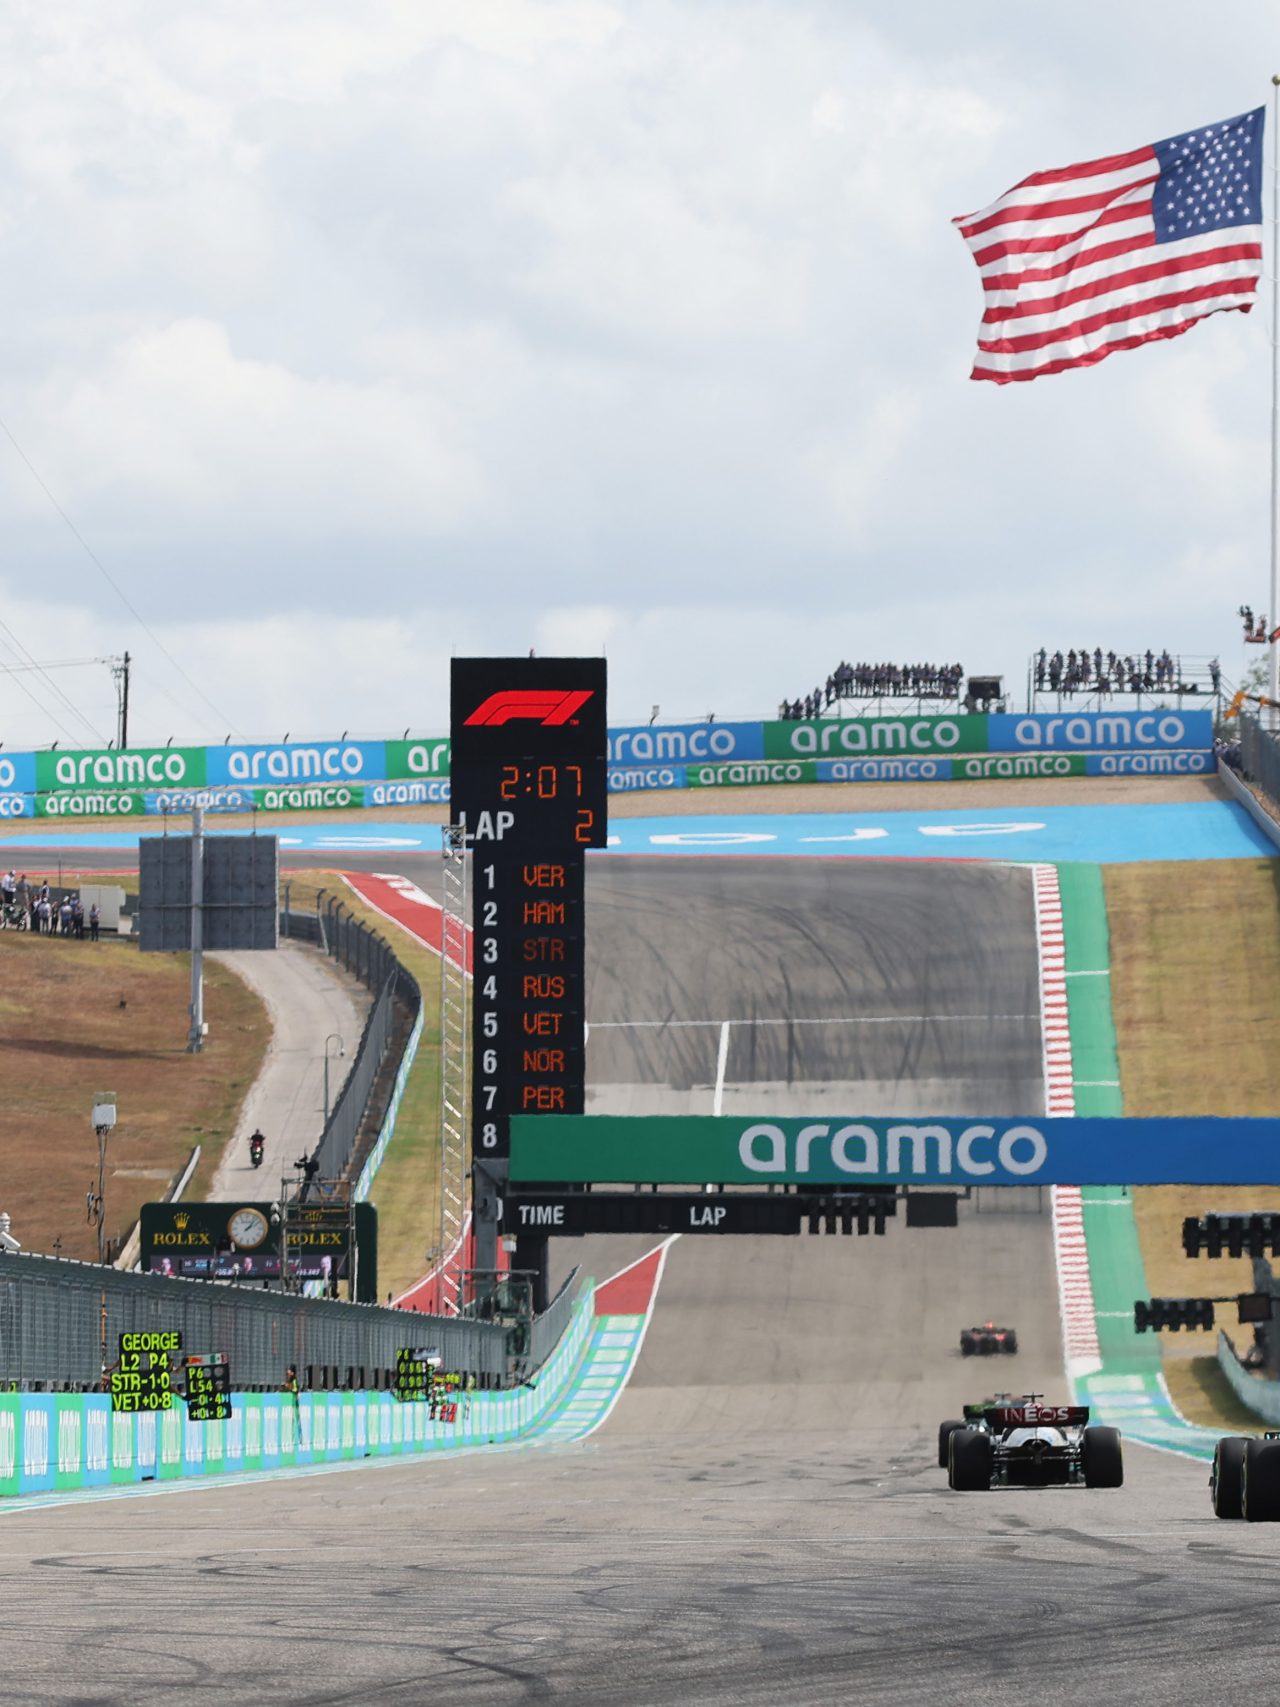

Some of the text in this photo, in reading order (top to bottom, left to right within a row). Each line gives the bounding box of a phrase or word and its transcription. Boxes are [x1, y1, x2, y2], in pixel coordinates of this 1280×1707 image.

[790, 721, 960, 752] aramco
[1015, 716, 1185, 745] aramco
[607, 729, 736, 761] ramco
[56, 754, 186, 785] aramco
[228, 747, 363, 779] aramco
[700, 764, 801, 785] aramco
[832, 761, 937, 779] aramco
[965, 757, 1071, 777] aramco
[1101, 753, 1205, 773] aramco
[501, 766, 582, 799] 2:07
[45, 795, 133, 814] aramco
[264, 788, 351, 809] aramco
[459, 809, 593, 842] LAP 2
[483, 864, 565, 890] 1 VER
[483, 902, 565, 926] 2 HAM
[483, 938, 565, 964] 3 STR
[483, 975, 565, 1000] 4 RUS
[483, 1013, 562, 1038] 5 VET
[483, 1050, 565, 1074] 6 NOR
[483, 1086, 565, 1111] 7 PER
[483, 1123, 497, 1149] 8
[739, 1124, 1047, 1176] aramco
[518, 1205, 565, 1225] TIME
[690, 1206, 727, 1226] LAP
[153, 1232, 211, 1245] ROLEX
[287, 1232, 342, 1245] ROLEX
[122, 1332, 180, 1351] GEORGE
[121, 1353, 169, 1371] L2 P4
[1004, 1407, 1069, 1423] INEOS
